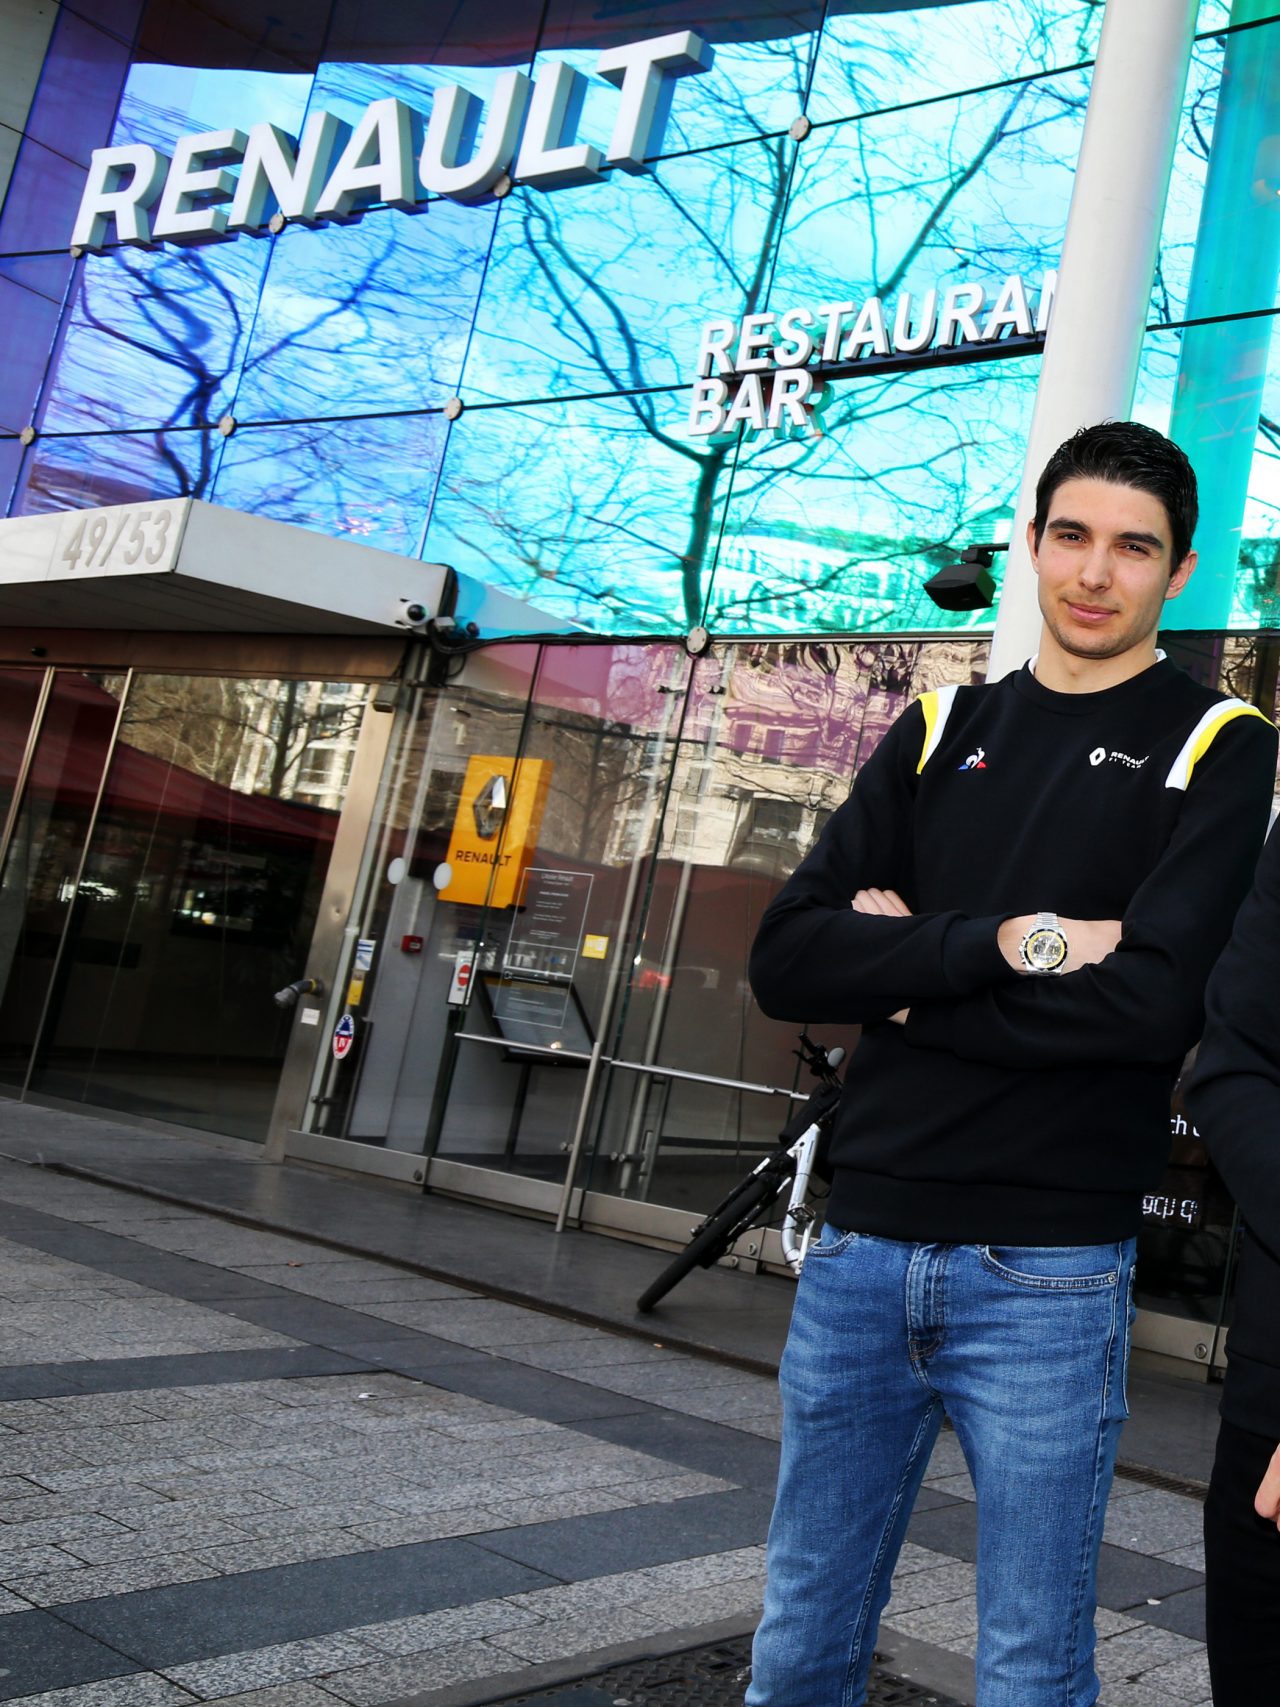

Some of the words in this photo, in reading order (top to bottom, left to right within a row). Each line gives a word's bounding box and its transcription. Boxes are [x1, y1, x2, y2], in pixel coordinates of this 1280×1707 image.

[70, 30, 714, 251] RENAULT
[688, 368, 814, 436] BAR
[62, 509, 170, 571] 49/53
[455, 849, 513, 867] RENAULT
